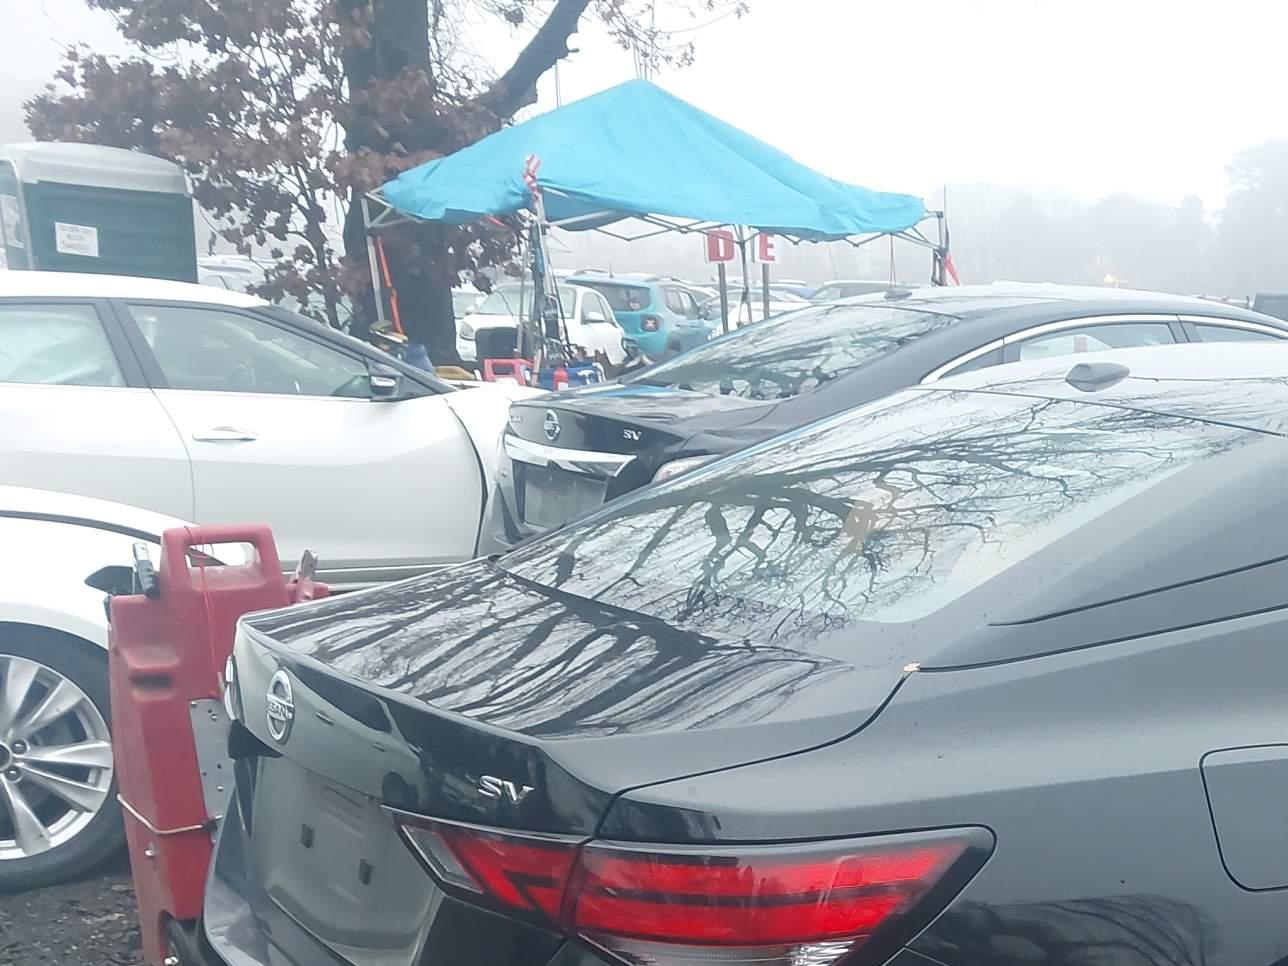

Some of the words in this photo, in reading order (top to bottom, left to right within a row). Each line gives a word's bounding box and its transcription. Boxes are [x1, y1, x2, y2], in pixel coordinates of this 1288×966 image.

[707, 229, 734, 262] D
[759, 231, 775, 262] E
[622, 428, 642, 441] SV
[477, 775, 536, 805] SV
